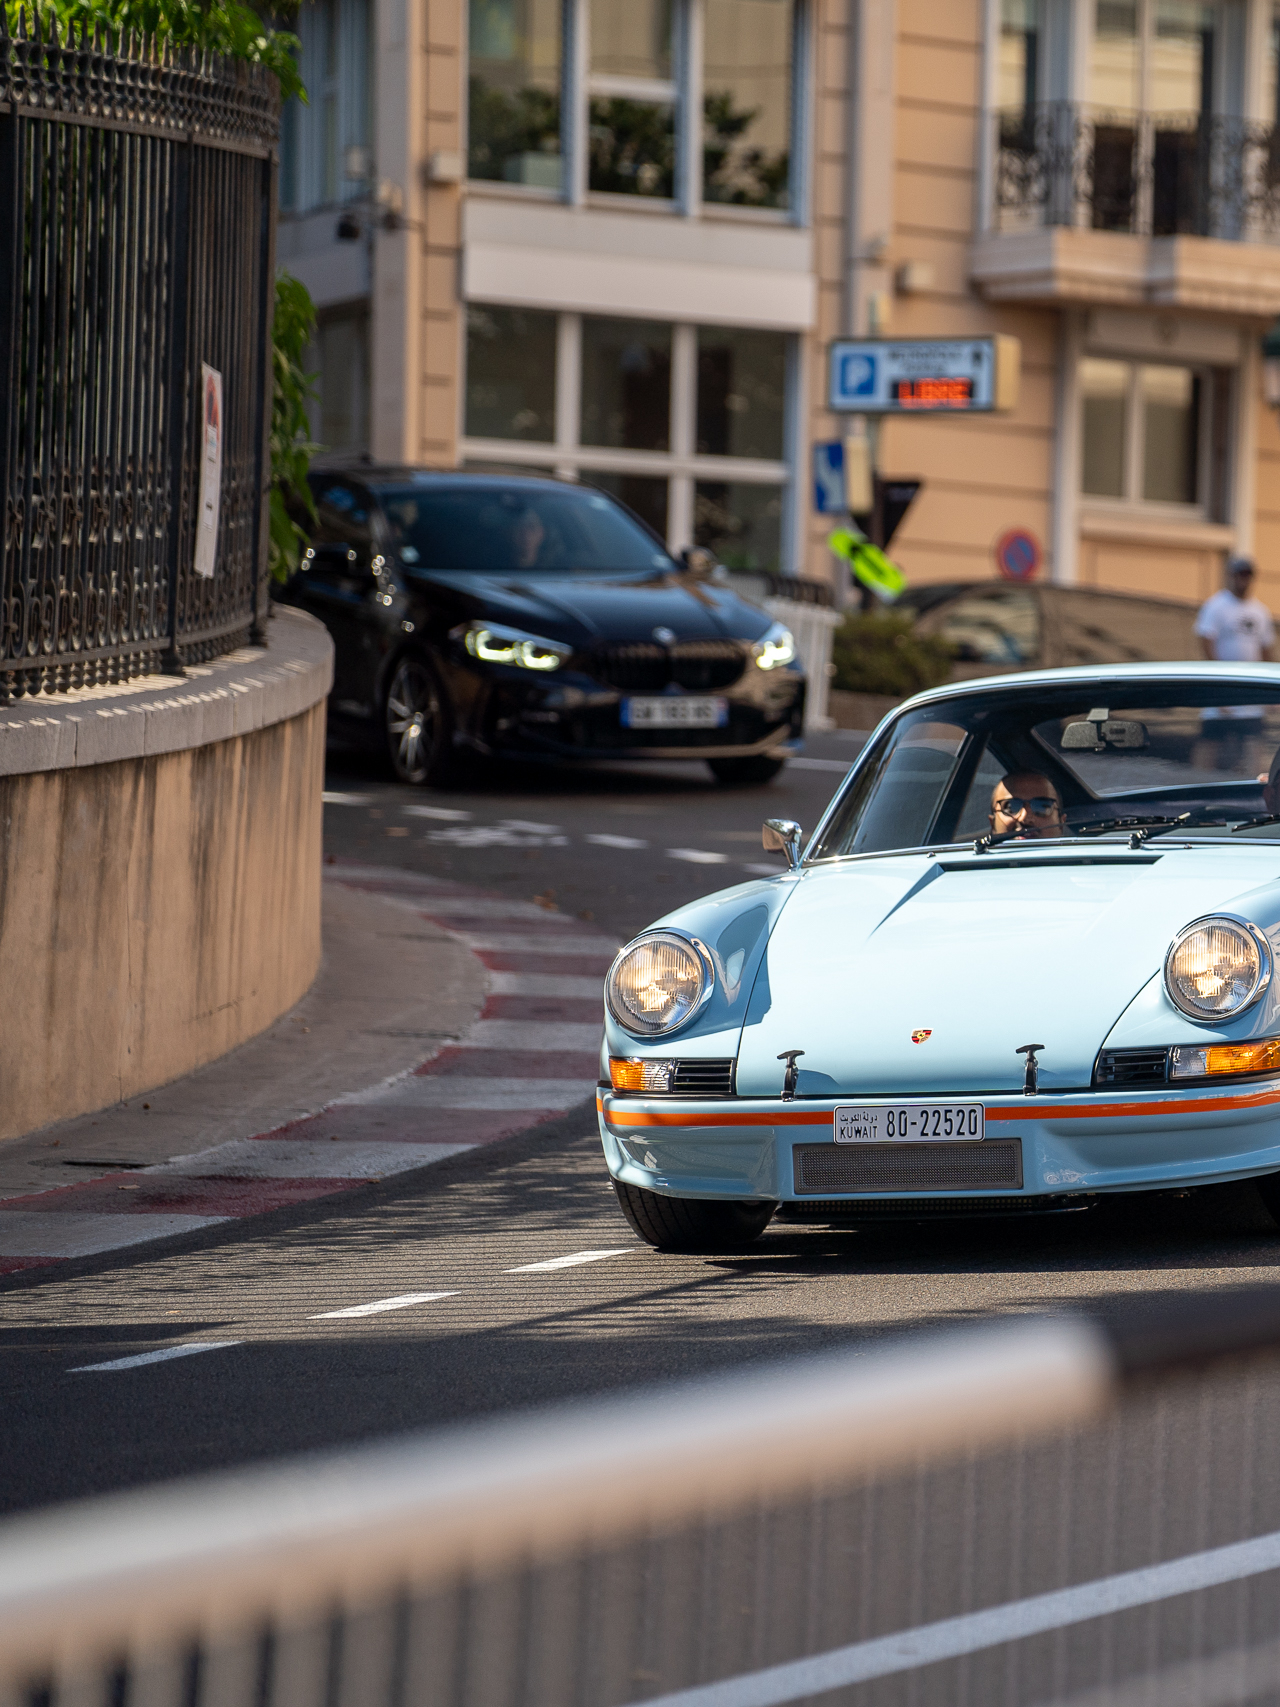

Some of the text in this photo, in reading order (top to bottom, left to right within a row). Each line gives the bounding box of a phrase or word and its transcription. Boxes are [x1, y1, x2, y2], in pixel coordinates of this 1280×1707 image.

[844, 356, 872, 394] P
[839, 1111, 878, 1125] دولة الكويت
[886, 1108, 979, 1138] 80-22520
[839, 1125, 878, 1139] KUWAIT
